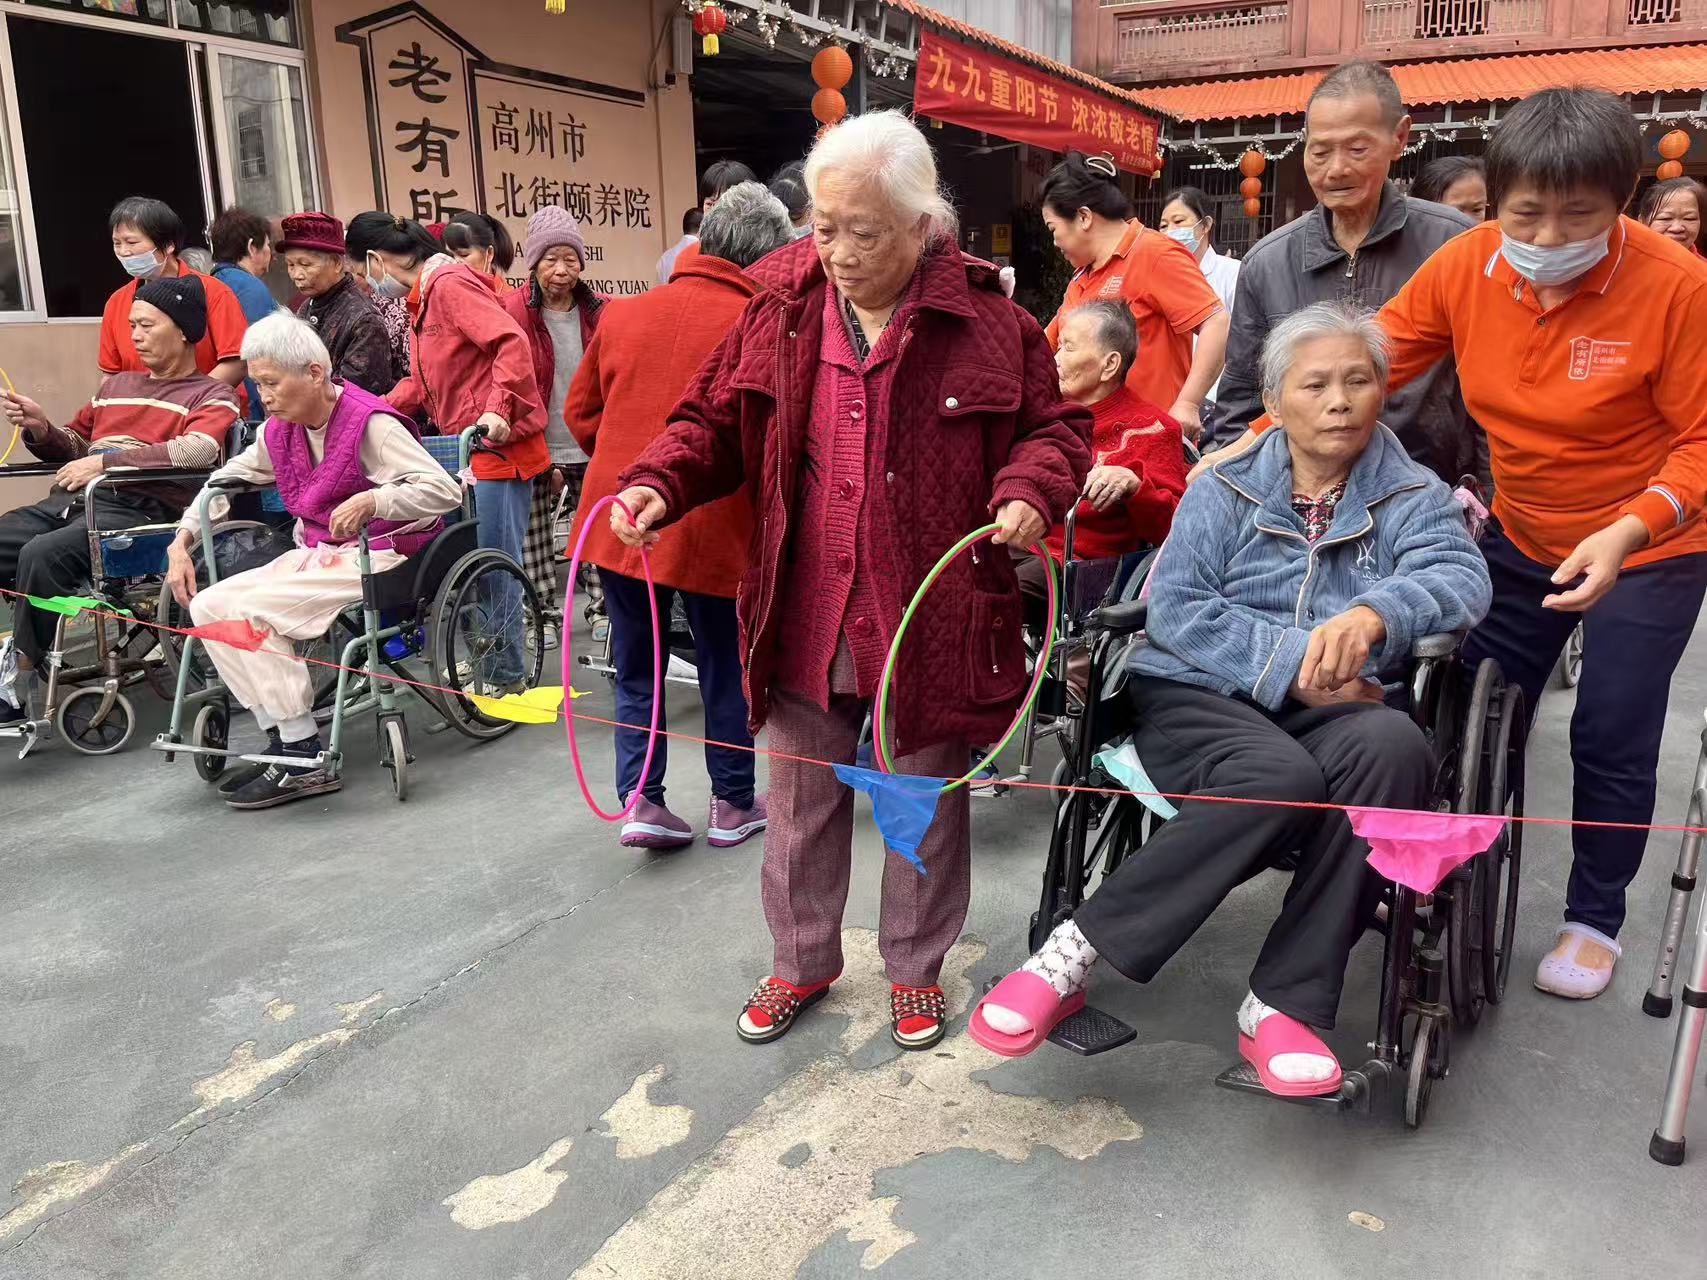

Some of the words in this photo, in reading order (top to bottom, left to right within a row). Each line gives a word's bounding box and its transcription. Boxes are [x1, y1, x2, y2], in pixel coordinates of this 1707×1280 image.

[927, 47, 1059, 124] 九九重阳节
[1071, 96, 1154, 158] 浓浓敬老情
[487, 101, 587, 163] 高州市
[494, 171, 652, 229] 北街颐养院
[583, 245, 604, 261] SHI
[585, 279, 614, 295] ANG
[616, 280, 649, 295] YUAN
